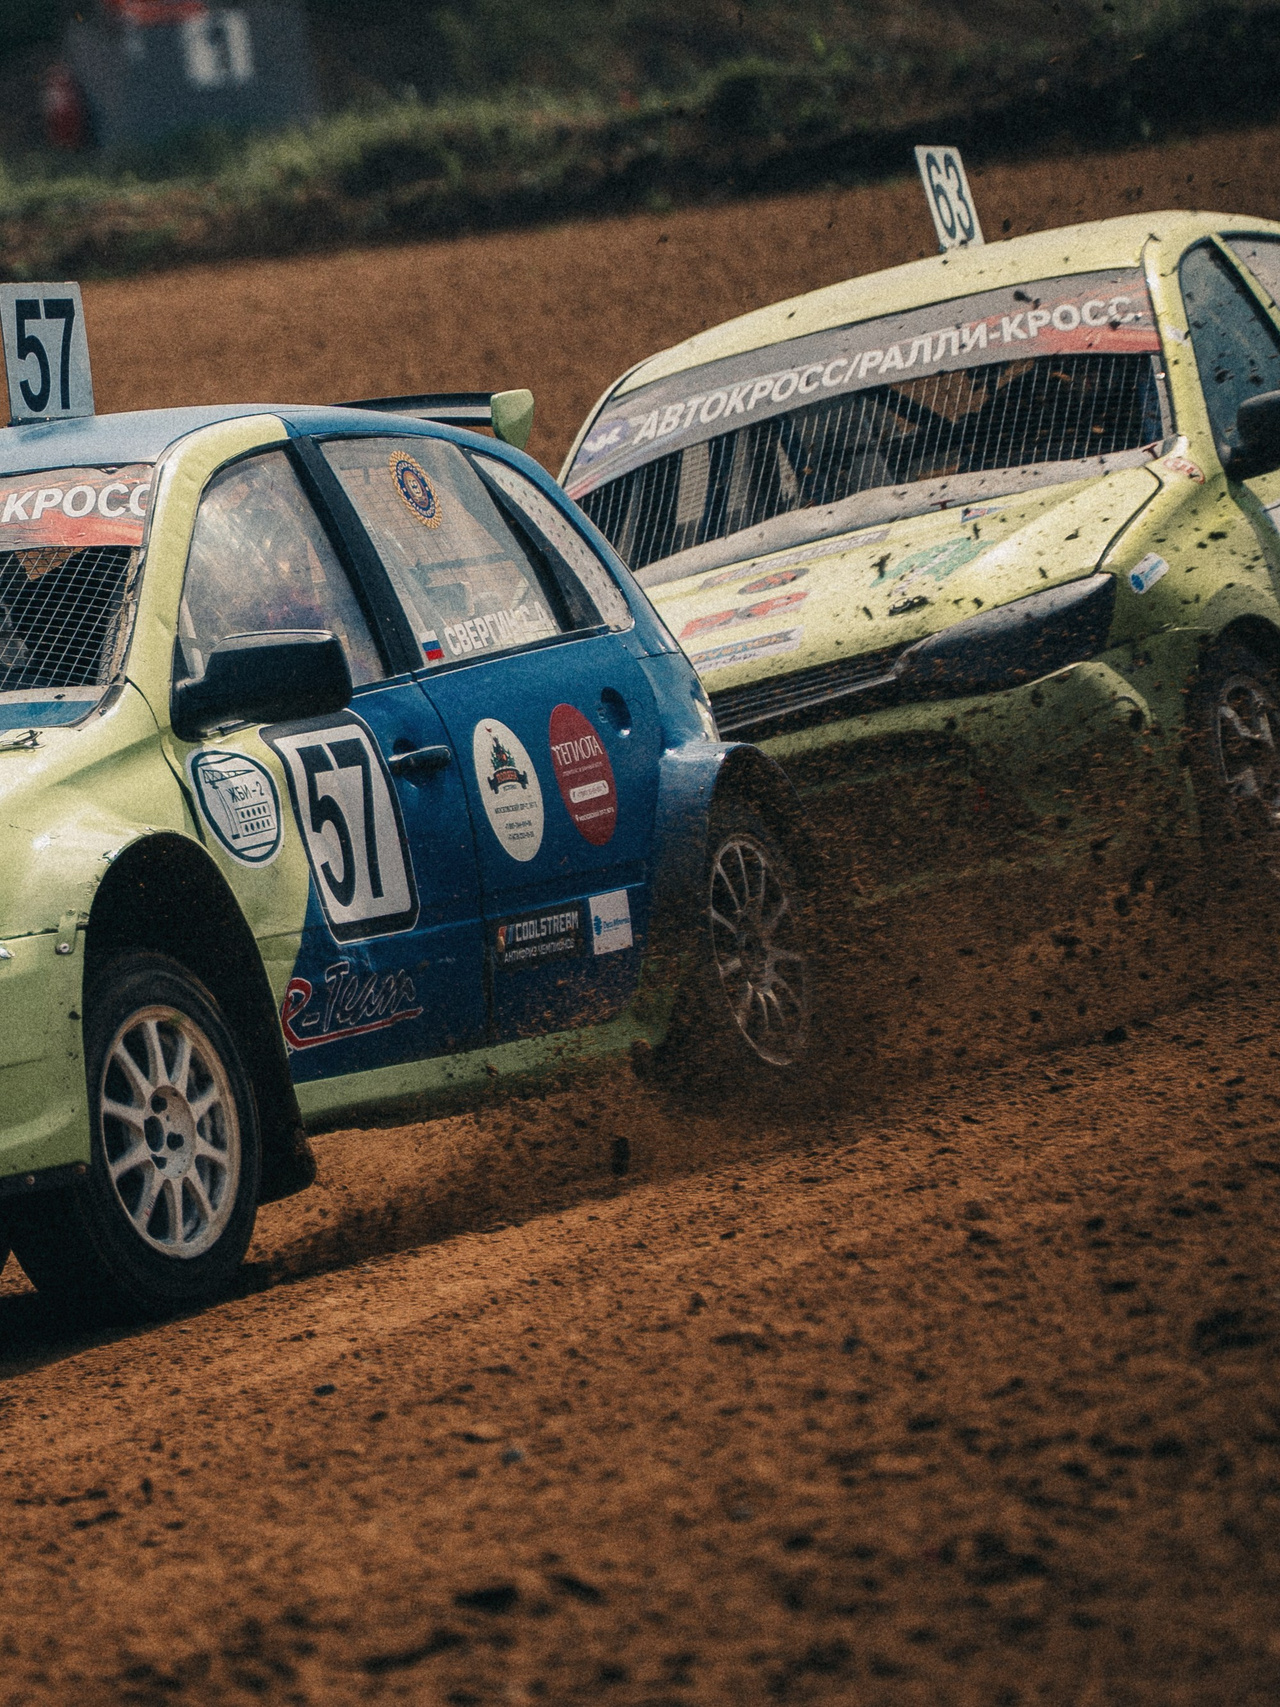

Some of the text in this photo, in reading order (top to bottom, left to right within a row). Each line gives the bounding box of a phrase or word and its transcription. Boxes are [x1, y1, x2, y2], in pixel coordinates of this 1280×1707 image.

[926, 152, 975, 240] 63
[15, 298, 76, 413] 57
[295, 737, 385, 908] 57
[515, 911, 580, 943] COOLSTREAM
